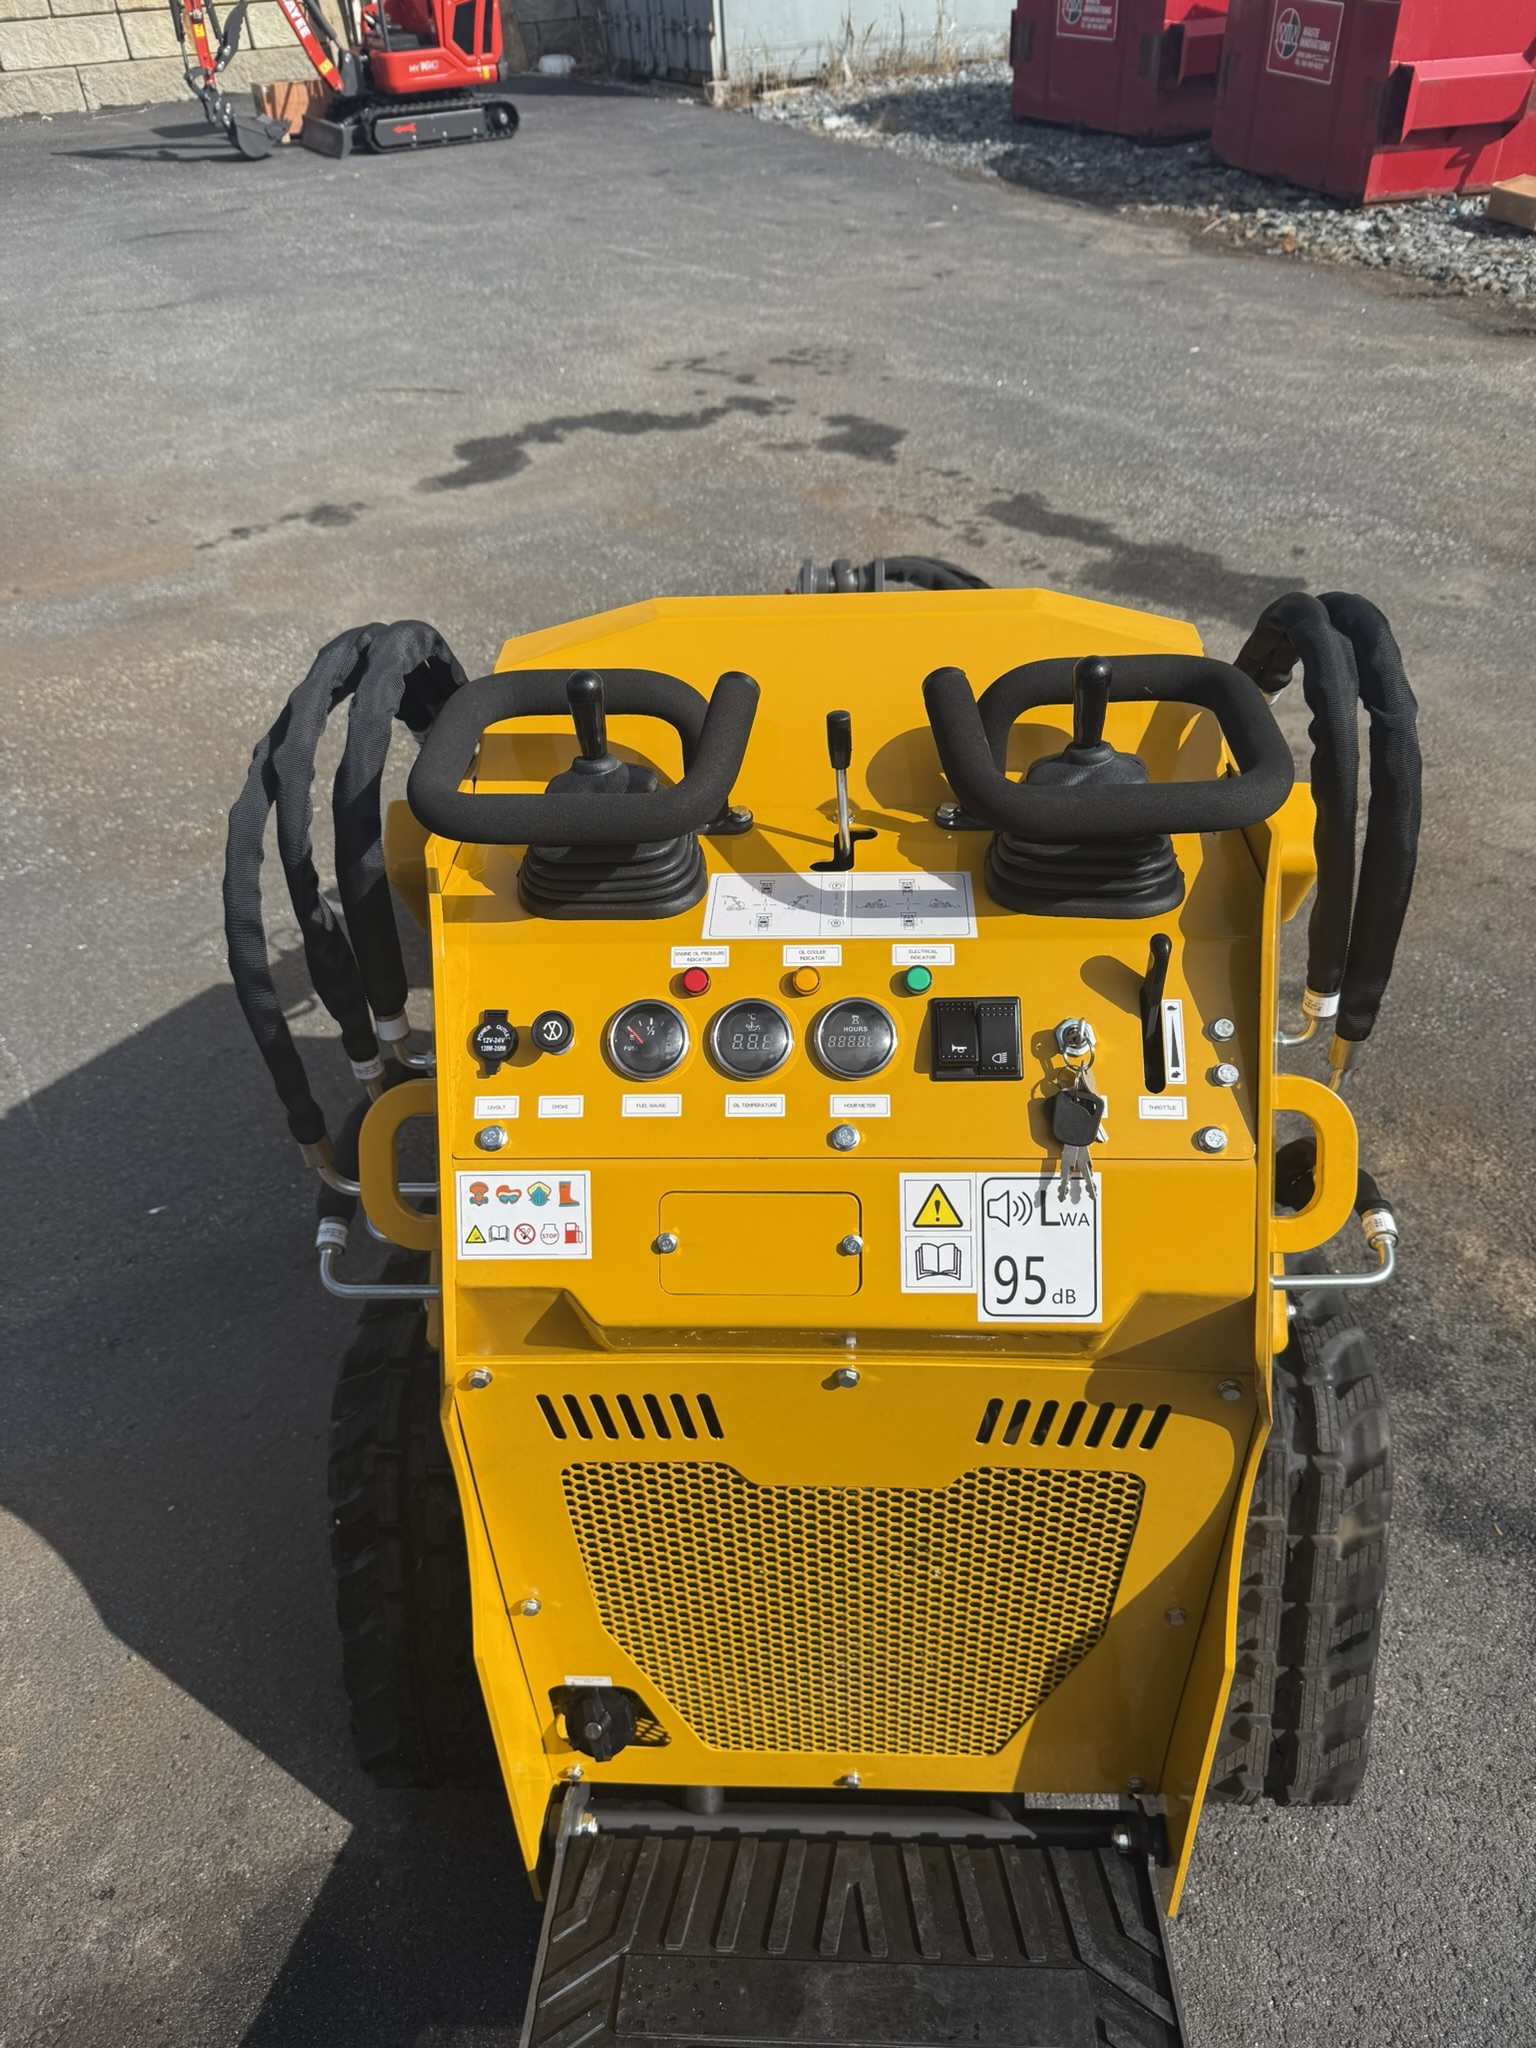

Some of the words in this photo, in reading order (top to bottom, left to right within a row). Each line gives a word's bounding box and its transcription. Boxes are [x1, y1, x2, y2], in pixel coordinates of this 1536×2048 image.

[477, 1025, 492, 1041] POWER
[496, 1024, 511, 1040] OUTLET
[994, 1255, 1046, 1304] 95
[1052, 1288, 1076, 1304] dB
